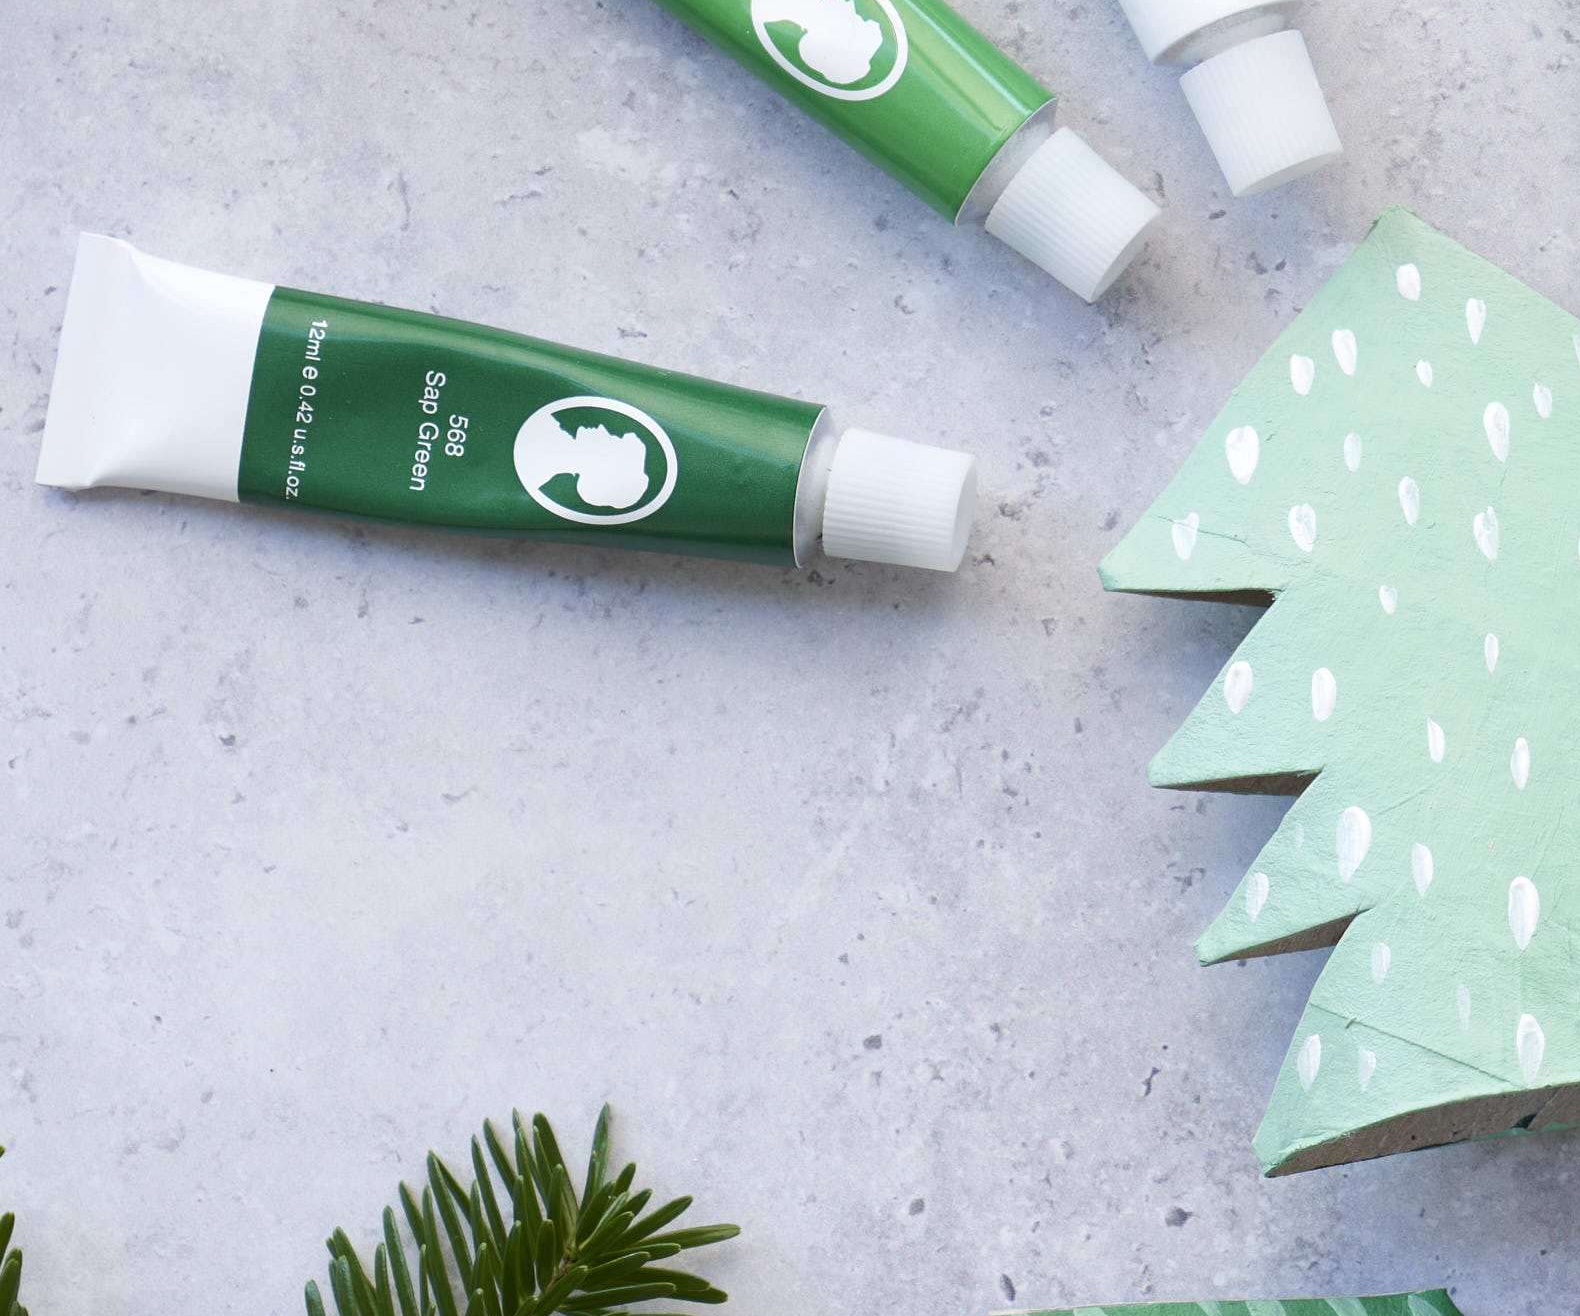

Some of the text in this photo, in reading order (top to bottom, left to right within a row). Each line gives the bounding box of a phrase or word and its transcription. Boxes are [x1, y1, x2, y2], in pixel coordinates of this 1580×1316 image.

[304, 319, 329, 362] 12ml
[295, 384, 317, 424] 0.42
[408, 370, 447, 492] Sap Green
[444, 413, 469, 458] 568
[284, 428, 308, 500] u.s.fl.oz.
